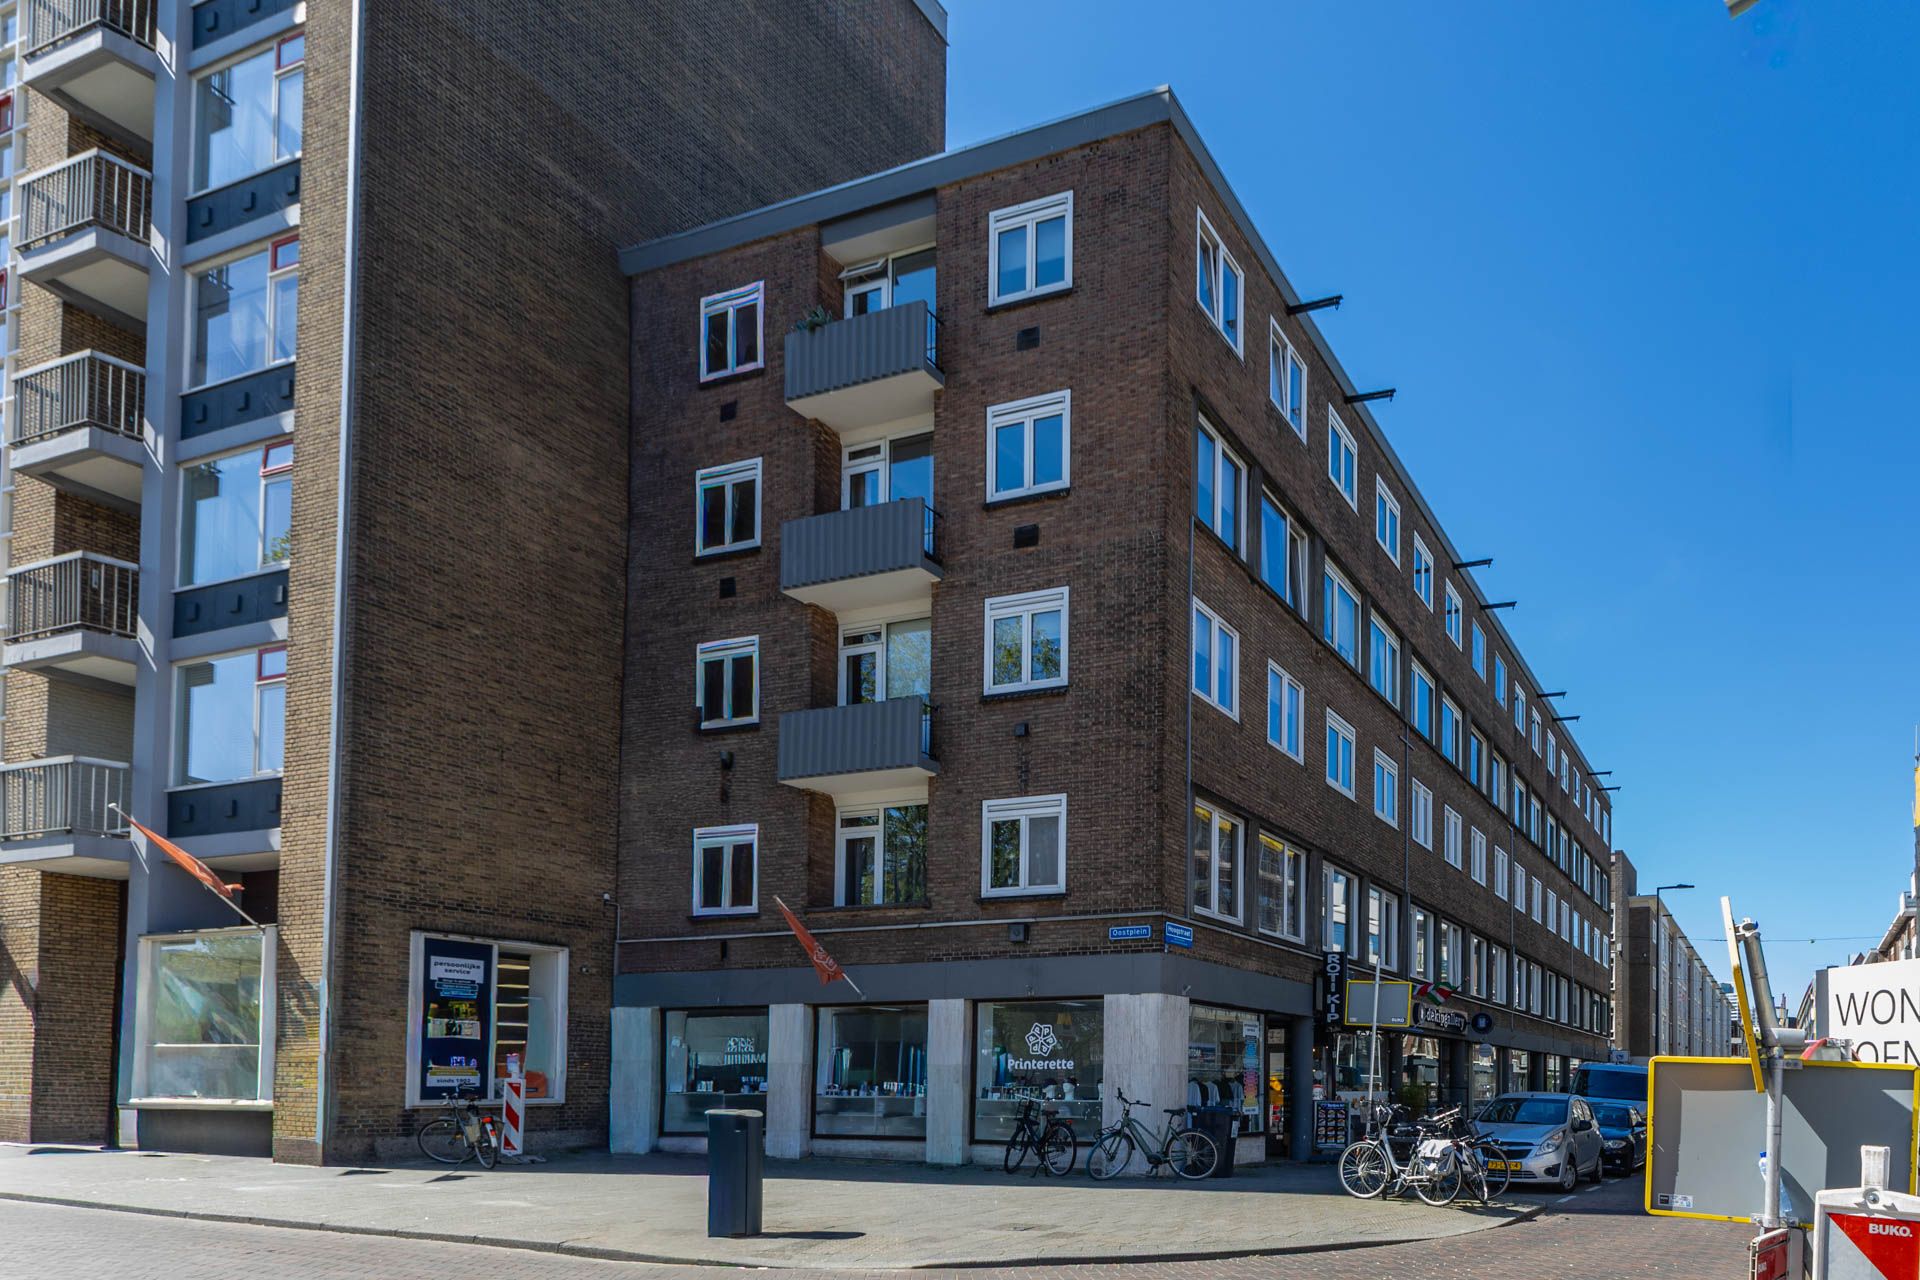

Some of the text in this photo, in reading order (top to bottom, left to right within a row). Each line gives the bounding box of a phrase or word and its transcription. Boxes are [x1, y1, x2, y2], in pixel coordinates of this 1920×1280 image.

[1112, 928, 1147, 936] Oostplein
[1167, 926, 1191, 937] Hoogstraat
[434, 961, 481, 970] persoonlijke
[1326, 954, 1341, 1023] ROTI KIP
[1835, 988, 1920, 1026] WON
[1856, 1040, 1920, 1064] OEN
[1008, 1058, 1074, 1070] Printerette
